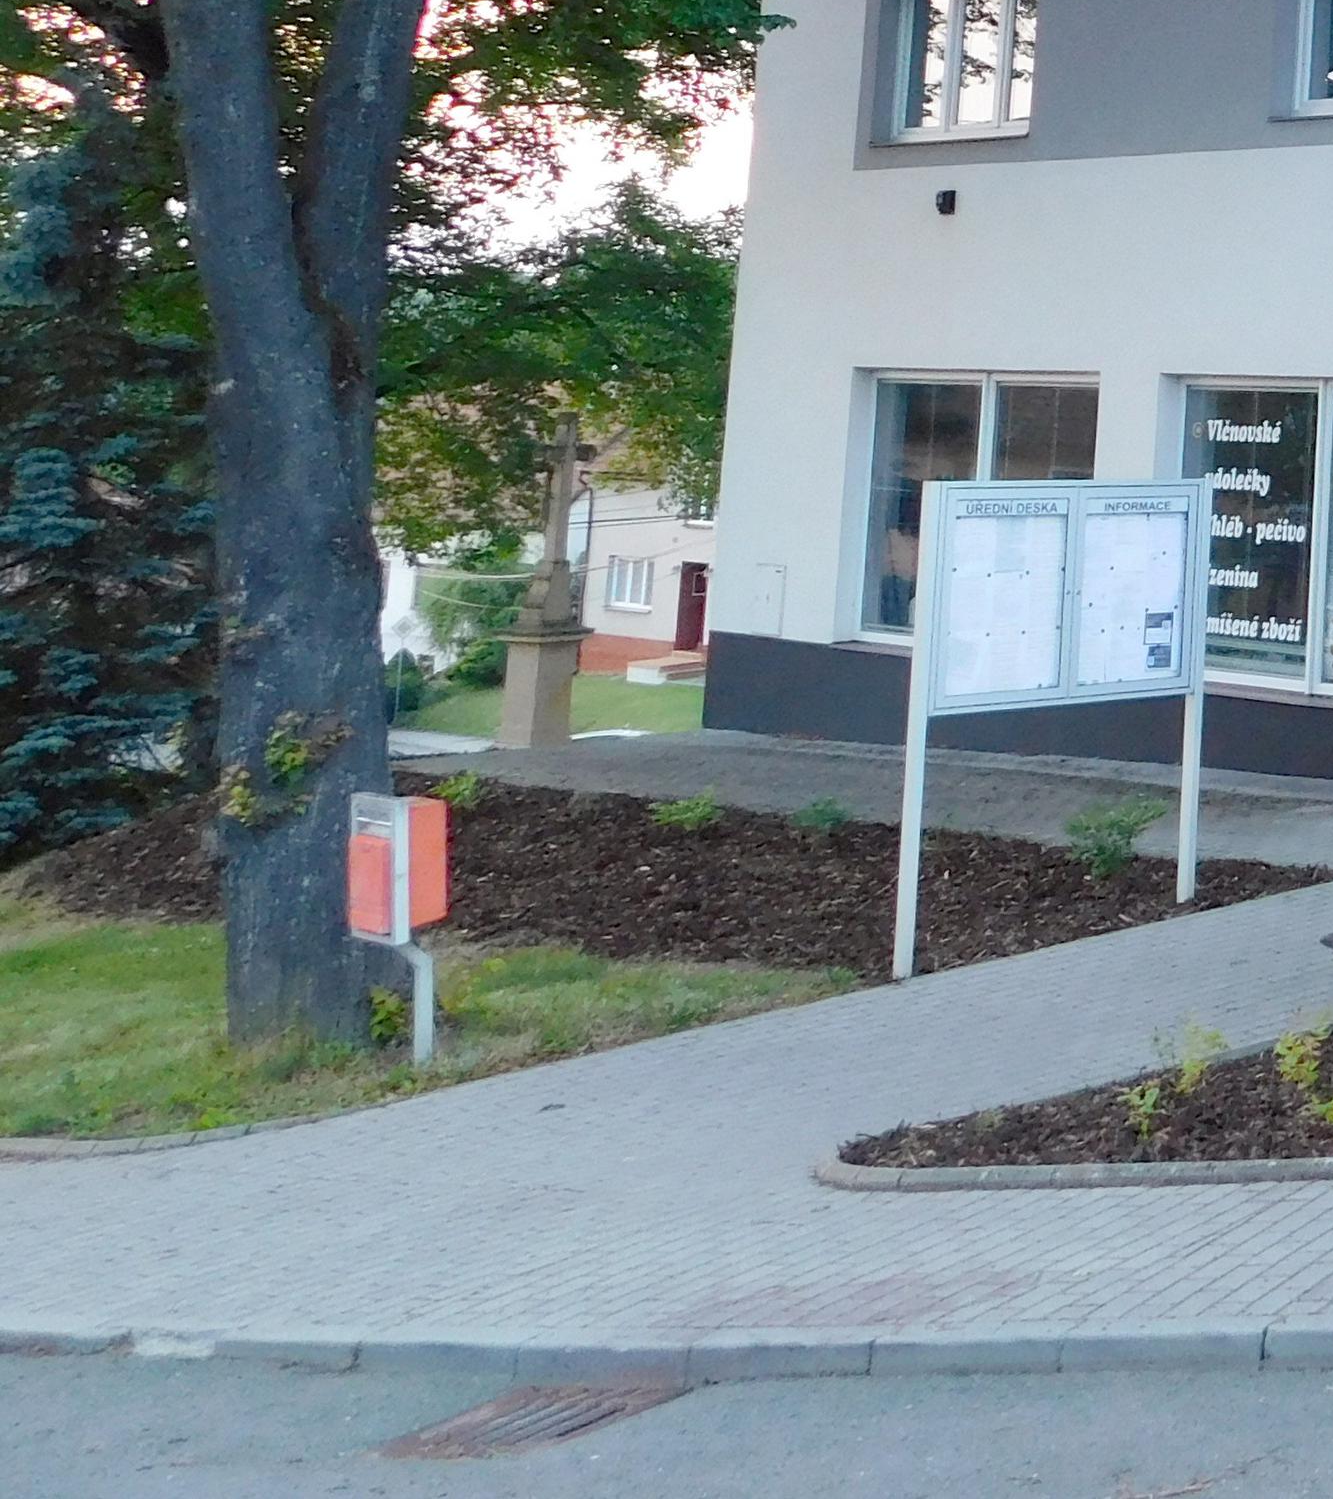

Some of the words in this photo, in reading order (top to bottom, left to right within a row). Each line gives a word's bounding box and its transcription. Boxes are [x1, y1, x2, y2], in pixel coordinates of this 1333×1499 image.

[1207, 419, 1282, 444] Vlčnovské
[1016, 501, 1058, 514] DESKA
[1104, 500, 1171, 512] INFORMACE
[1211, 514, 1243, 538] hléb
[1255, 518, 1306, 545] pečivo
[1208, 563, 1259, 589] zenina
[1206, 612, 1259, 638] míšené
[1261, 616, 1302, 642] zboží
